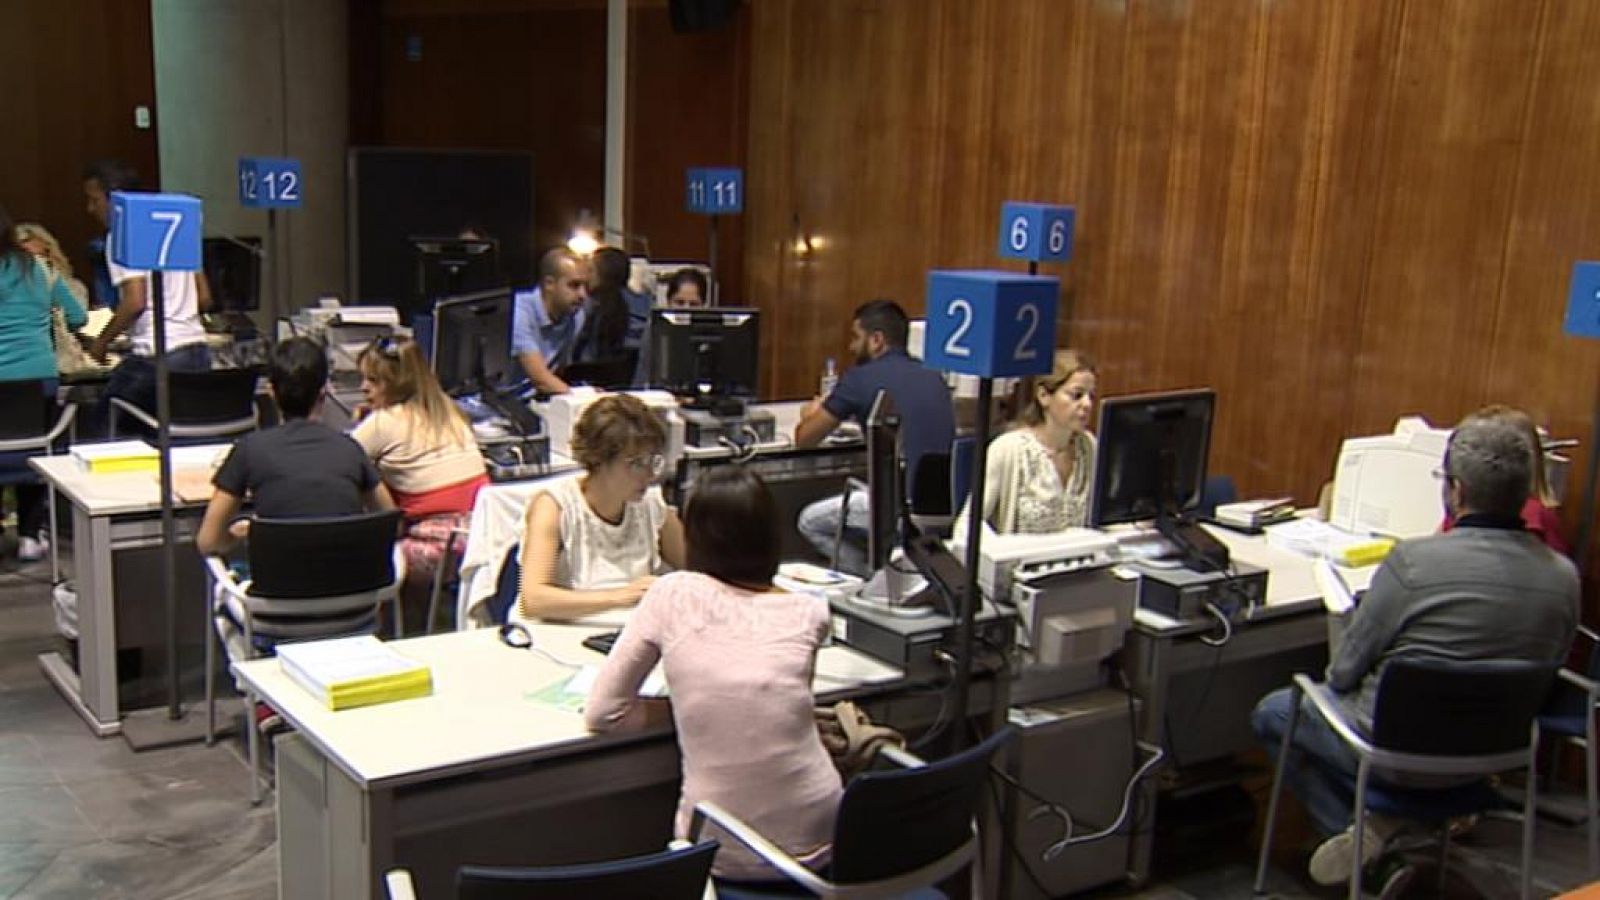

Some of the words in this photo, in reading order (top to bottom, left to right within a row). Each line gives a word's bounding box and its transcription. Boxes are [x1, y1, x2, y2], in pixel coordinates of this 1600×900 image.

[263, 171, 298, 200] 12
[689, 180, 704, 207] 11
[713, 181, 737, 207] 11
[151, 211, 183, 267] 7
[1011, 216, 1029, 251] 6
[1050, 219, 1065, 253] 6
[944, 299, 973, 357] 2
[1014, 303, 1040, 360] 2
